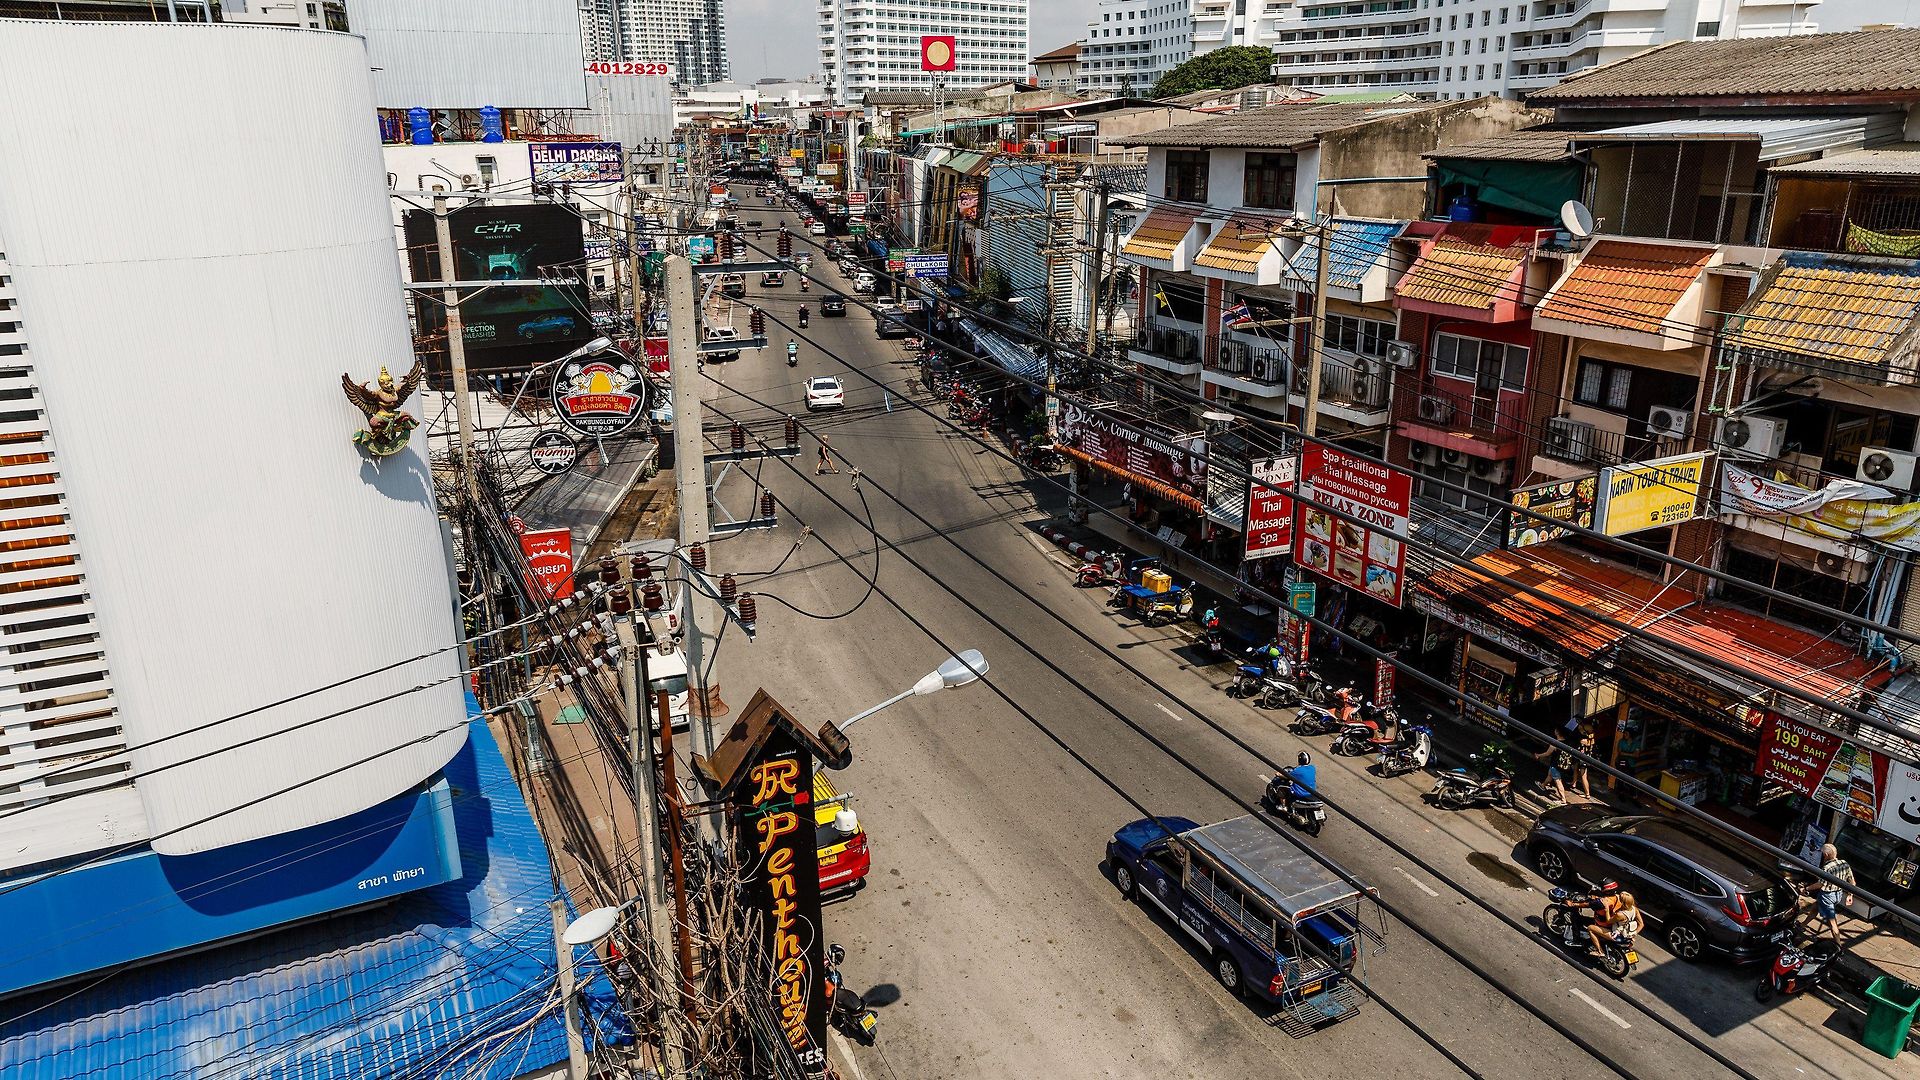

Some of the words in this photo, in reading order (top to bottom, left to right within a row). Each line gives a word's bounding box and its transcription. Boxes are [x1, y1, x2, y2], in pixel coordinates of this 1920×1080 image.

[532, 149, 567, 162] DELHI
[475, 223, 522, 234] C-HR
[466, 325, 495, 333] FECTION
[1110, 422, 1141, 443] Corner
[1142, 437, 1184, 463] Massage
[1254, 459, 1294, 475] RELAX
[1322, 449, 1340, 463] Spa
[1341, 455, 1390, 480] traditional
[1323, 463, 1343, 478] Thai
[1345, 470, 1387, 494] Massage
[1610, 476, 1635, 499] NARIN
[1637, 469, 1660, 490] TOUR
[1660, 469, 1667, 485] &
[1668, 467, 1697, 484] TRAVEL
[1750, 475, 1764, 495] 9
[1324, 479, 1358, 497] говорим
[1358, 491, 1370, 501] по
[1370, 494, 1399, 511] русски
[1261, 499, 1282, 513] Thai
[1313, 489, 1355, 517] RELAX
[1357, 505, 1395, 529] ZONE
[1661, 510, 1690, 523] 723160
[1662, 501, 1691, 514] 410040
[1249, 516, 1291, 532] Massage
[1260, 532, 1278, 545] Spa
[1775, 719, 1791, 730] ALL
[1792, 724, 1810, 737] YOU
[1810, 732, 1827, 743] EAT
[1774, 728, 1800, 748] 199
[1802, 744, 1828, 760] BAHT
[357, 874, 388, 889] สาขา
[392, 866, 425, 882] พัทยา
[755, 810, 809, 1049] Penthouse
